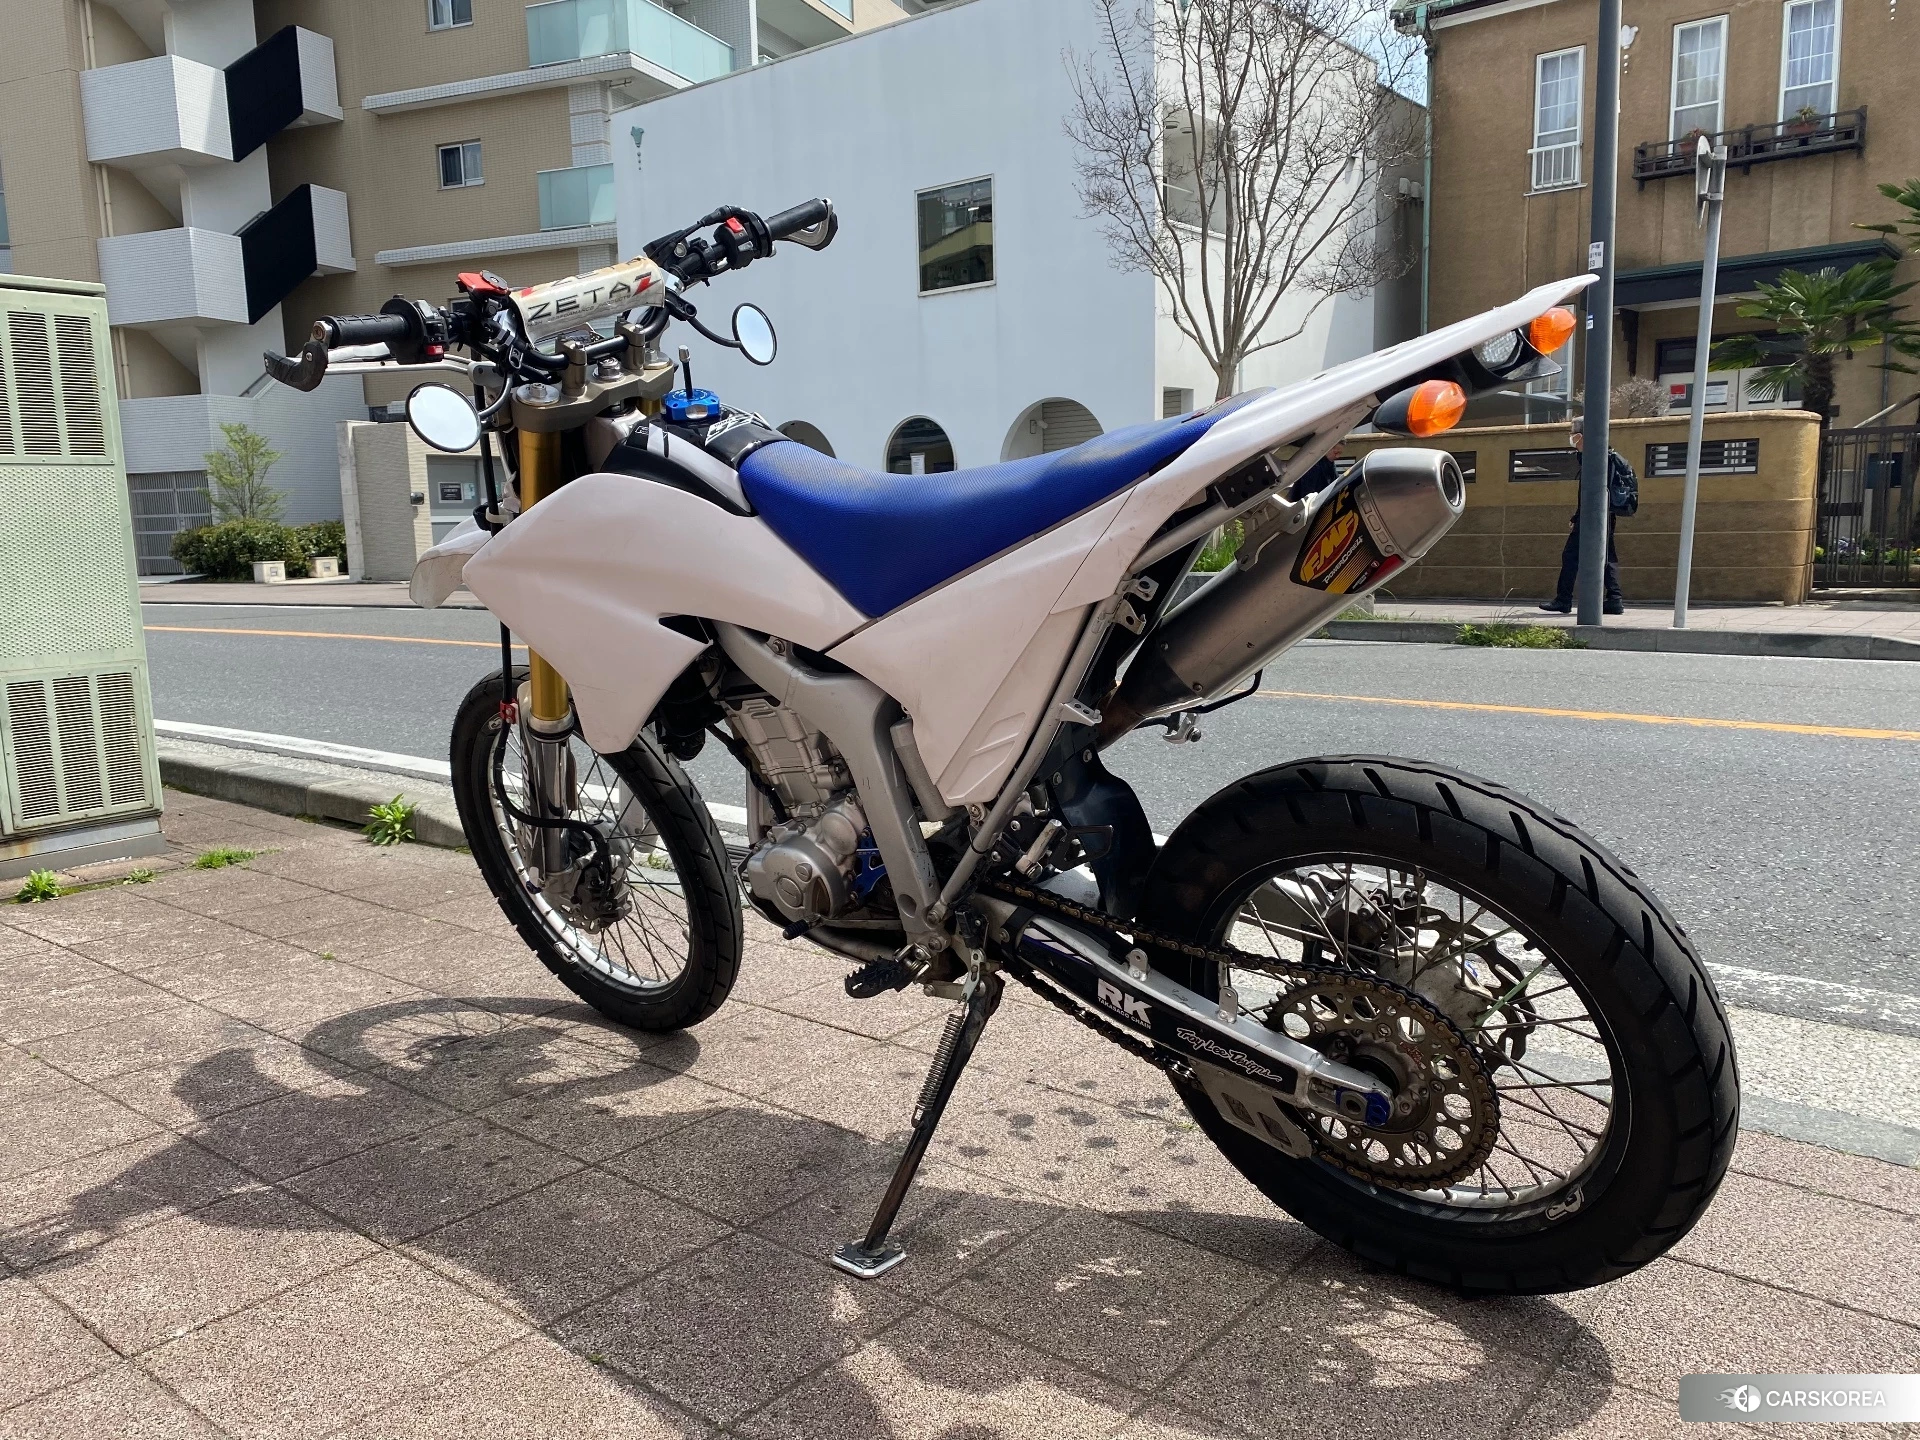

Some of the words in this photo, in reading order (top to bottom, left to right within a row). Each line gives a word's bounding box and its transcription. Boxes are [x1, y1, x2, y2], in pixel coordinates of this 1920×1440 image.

[528, 281, 631, 322] ZETA
[1302, 509, 1356, 583] FMF
[1097, 978, 1153, 1024] RK
[1097, 996, 1130, 1019] TAKASAGO
[1131, 1016, 1152, 1030] CHAIN
[1176, 1027, 1206, 1050] Troy
[1204, 1040, 1230, 1058] Lee
[1228, 1050, 1282, 1083] Designs
